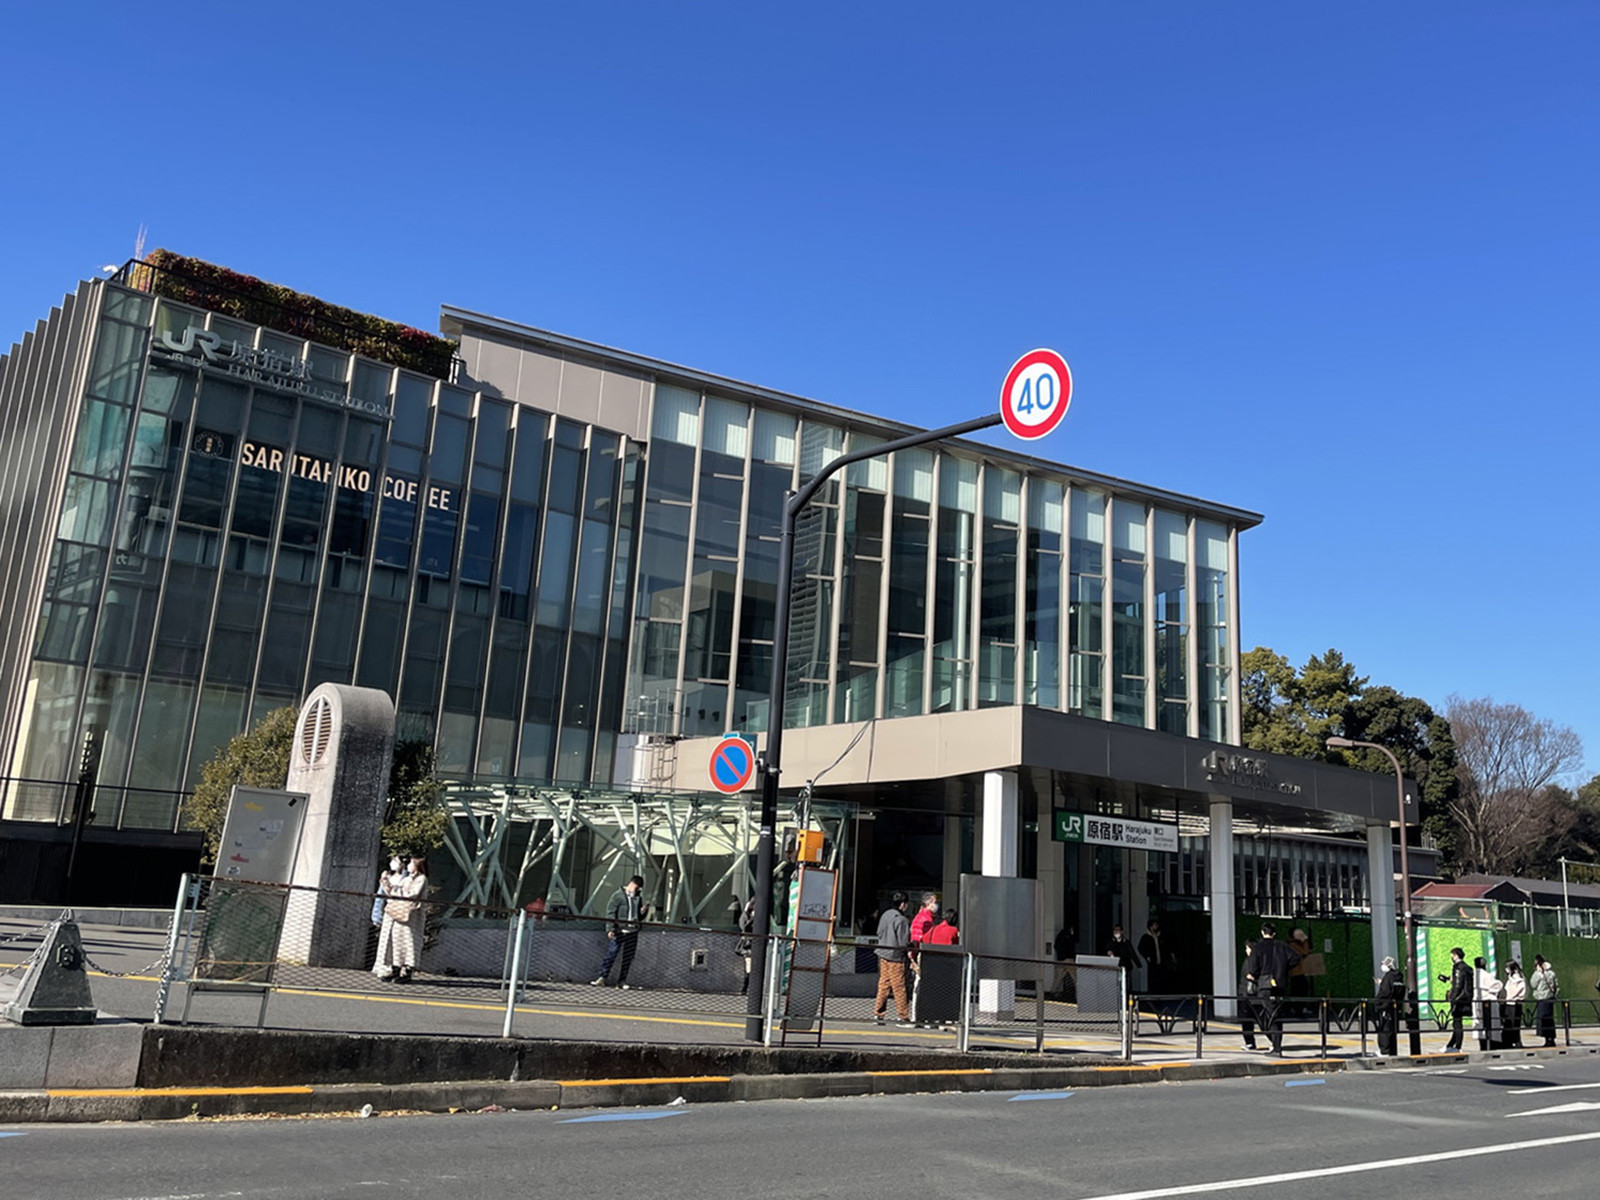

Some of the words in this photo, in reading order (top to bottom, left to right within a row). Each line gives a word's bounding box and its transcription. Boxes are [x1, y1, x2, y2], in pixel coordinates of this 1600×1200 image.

[162, 325, 220, 361] JR
[1017, 373, 1054, 414] 40
[383, 476, 451, 511] COFEE
[1062, 815, 1081, 833] JR
[1087, 820, 1124, 841] 原宿駅
[1125, 824, 1152, 836] Harajuku
[1125, 834, 1147, 845] Station
